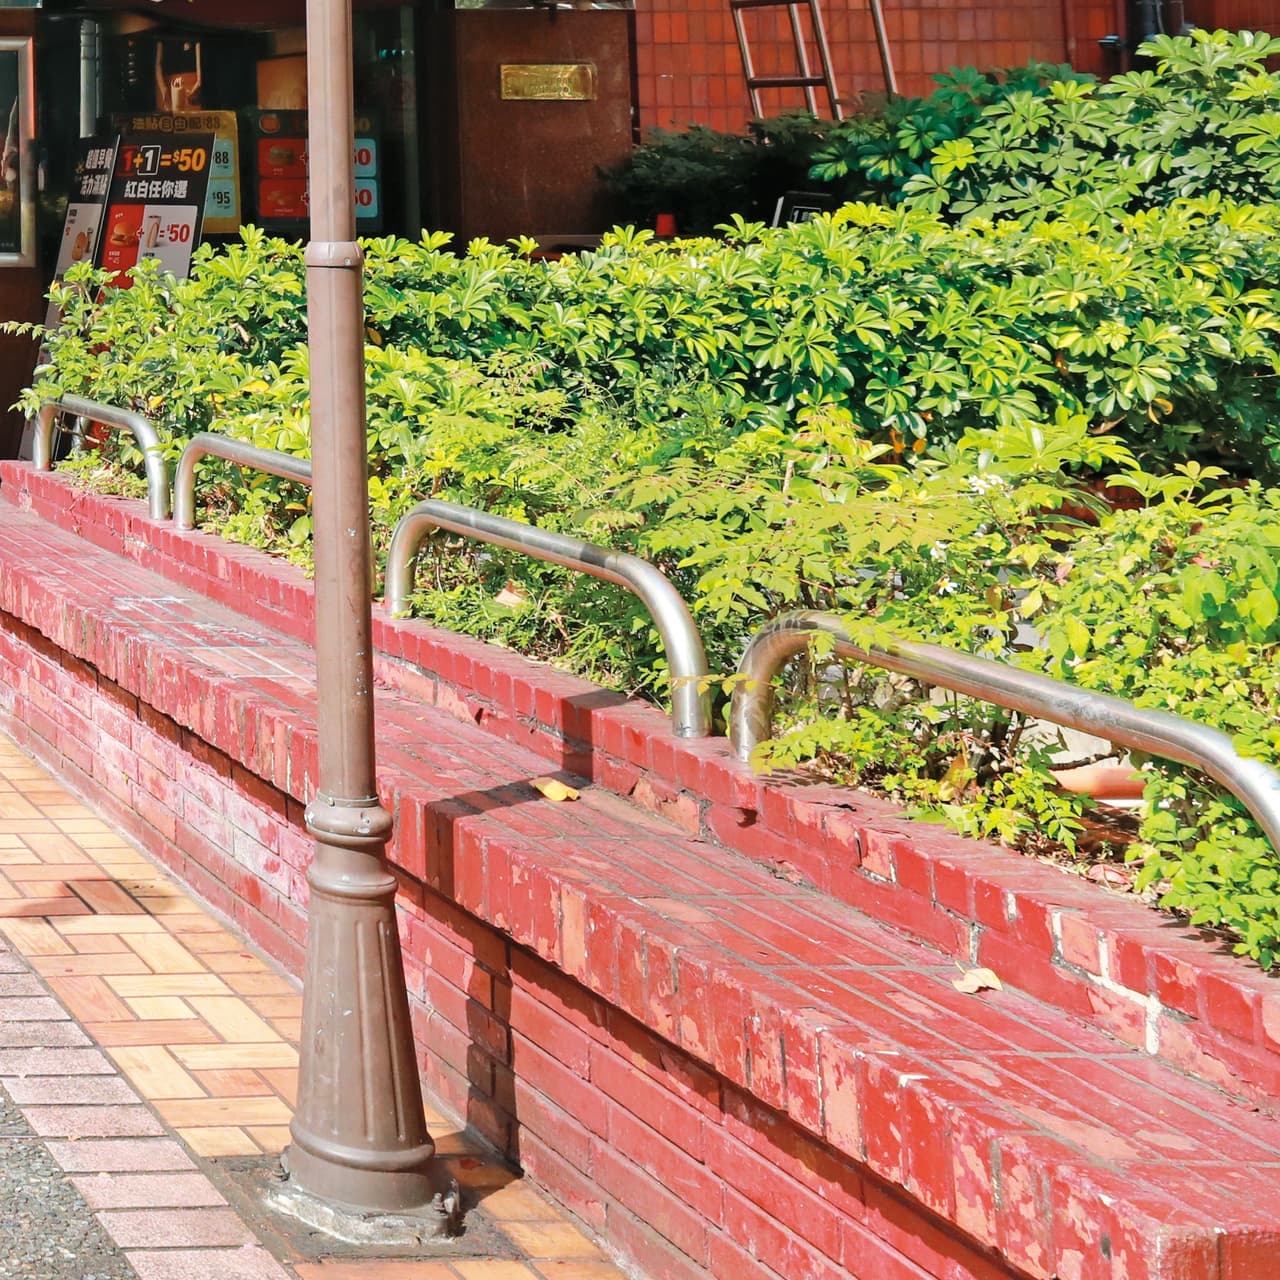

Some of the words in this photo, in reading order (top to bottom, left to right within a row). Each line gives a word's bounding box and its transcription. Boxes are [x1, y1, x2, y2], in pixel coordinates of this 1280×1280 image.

[124, 180, 189, 199] 紅白任你選
